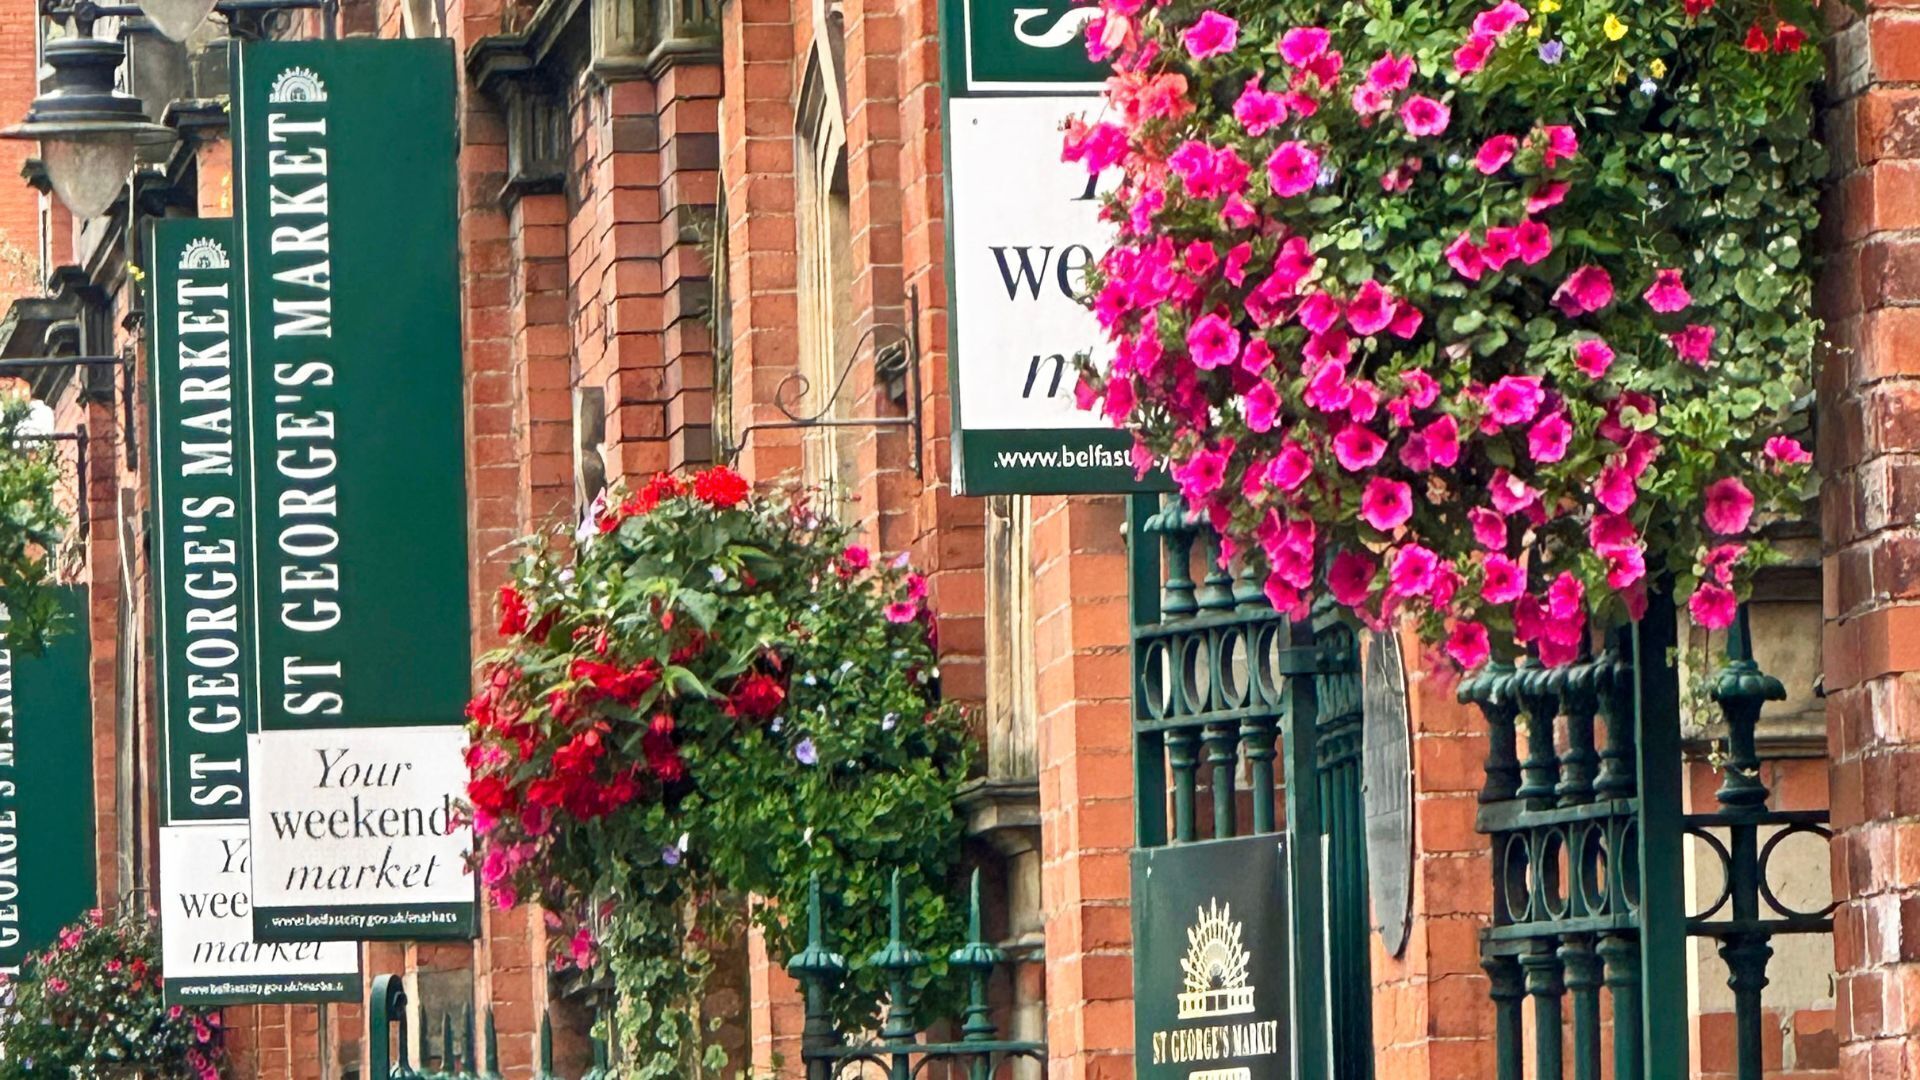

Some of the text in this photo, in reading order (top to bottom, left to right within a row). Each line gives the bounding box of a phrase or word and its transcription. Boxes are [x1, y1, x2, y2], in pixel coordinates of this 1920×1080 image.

[177, 278, 234, 477] MARKET
[268, 112, 344, 715] ST GEORGE'S MARKET
[181, 496, 242, 734] GEORGE'S
[189, 752, 243, 806] ST
[313, 748, 412, 789] Your
[271, 793, 452, 840] weekend
[285, 843, 441, 890] market
[1153, 1020, 1278, 1065] ST GEORGE'S MARKET
